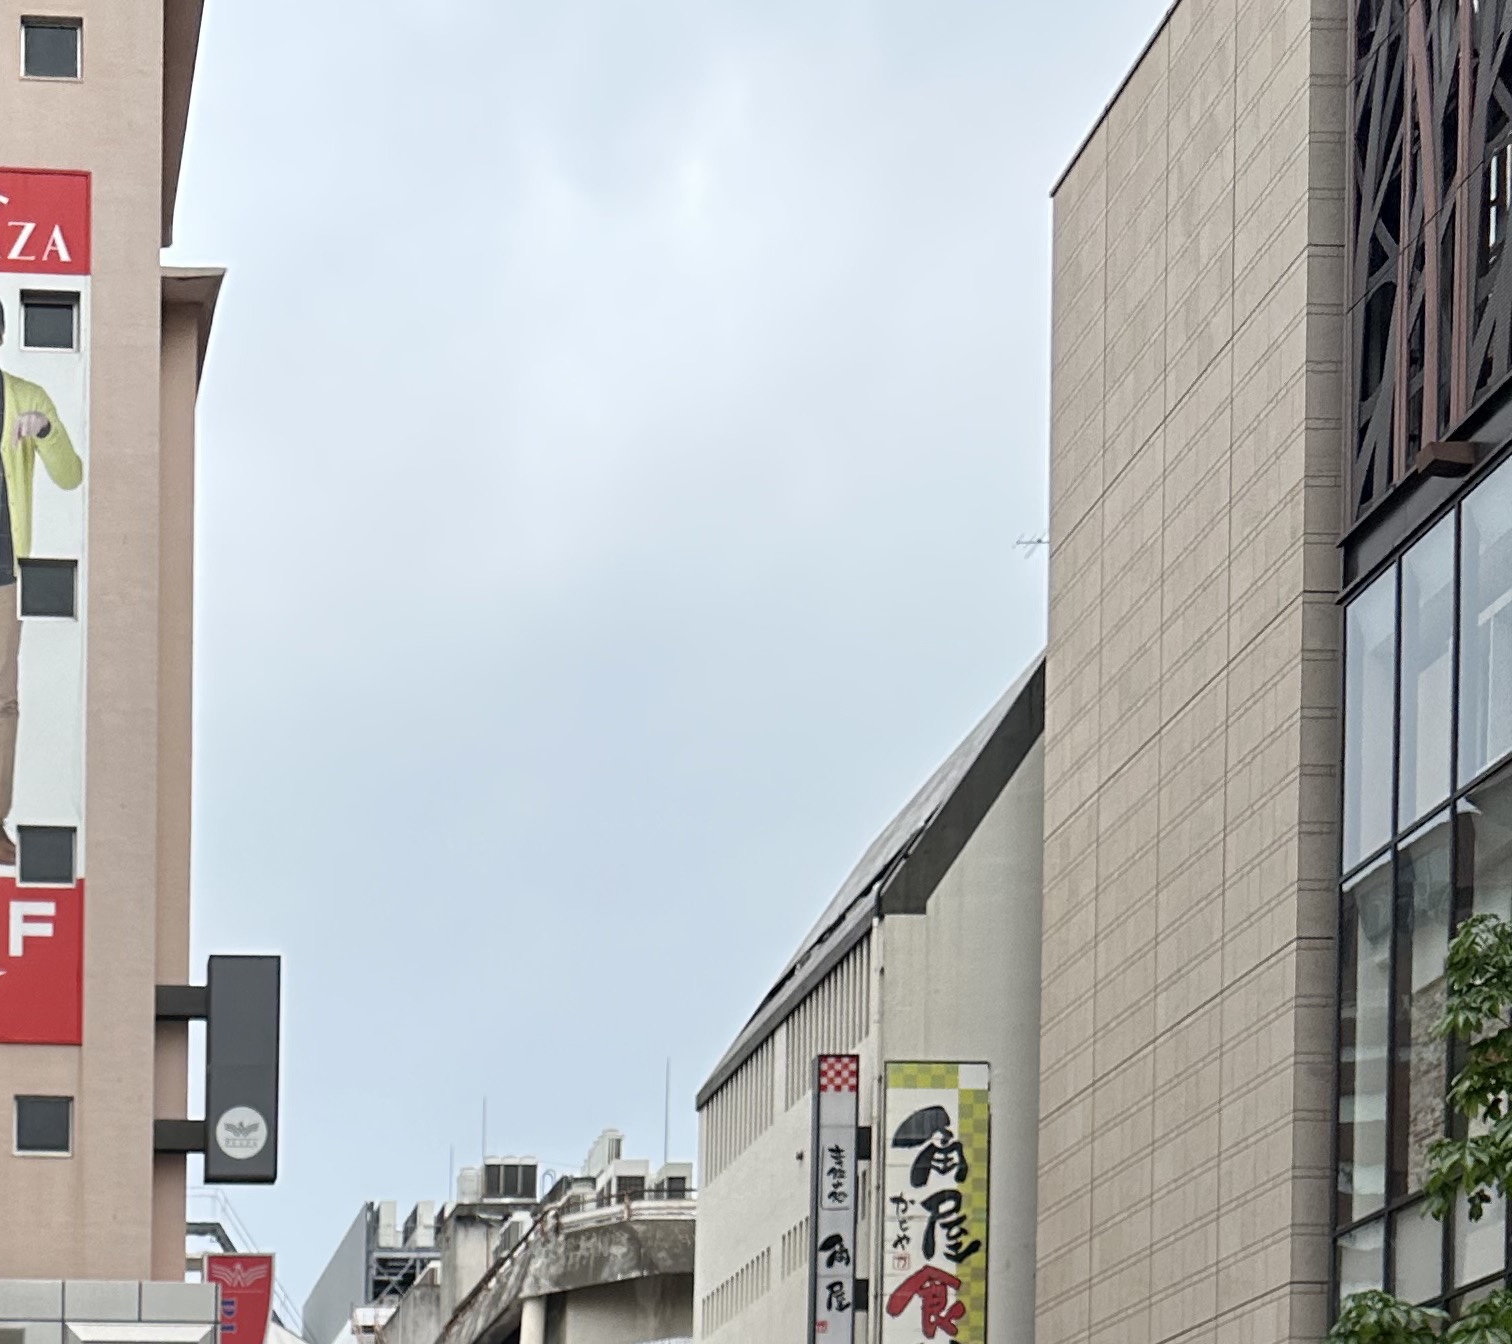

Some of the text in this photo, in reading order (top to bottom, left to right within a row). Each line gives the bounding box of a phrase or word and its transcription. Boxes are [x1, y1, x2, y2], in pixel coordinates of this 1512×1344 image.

[889, 1192, 915, 1250] かどや
[819, 1233, 852, 1312] 角屋
